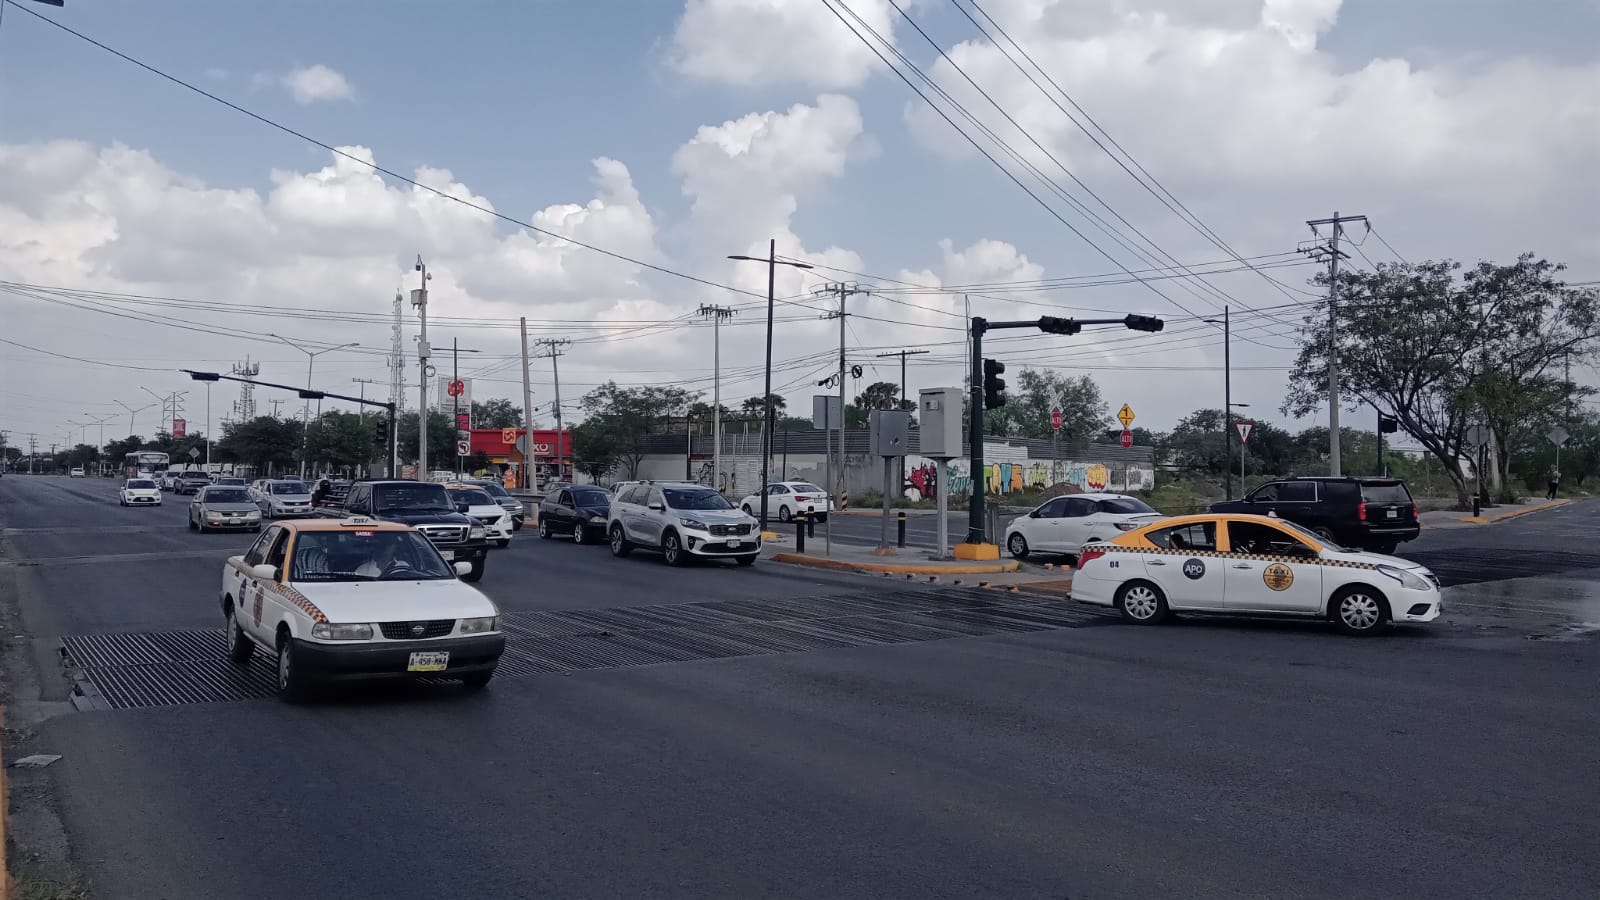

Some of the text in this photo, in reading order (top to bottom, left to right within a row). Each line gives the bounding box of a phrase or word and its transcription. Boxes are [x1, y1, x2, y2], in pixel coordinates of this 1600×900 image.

[1121, 435, 1133, 443] ALTO
[1109, 560, 1119, 568] 04
[1184, 564, 1203, 574] APO
[1268, 567, 1289, 575] TAXI
